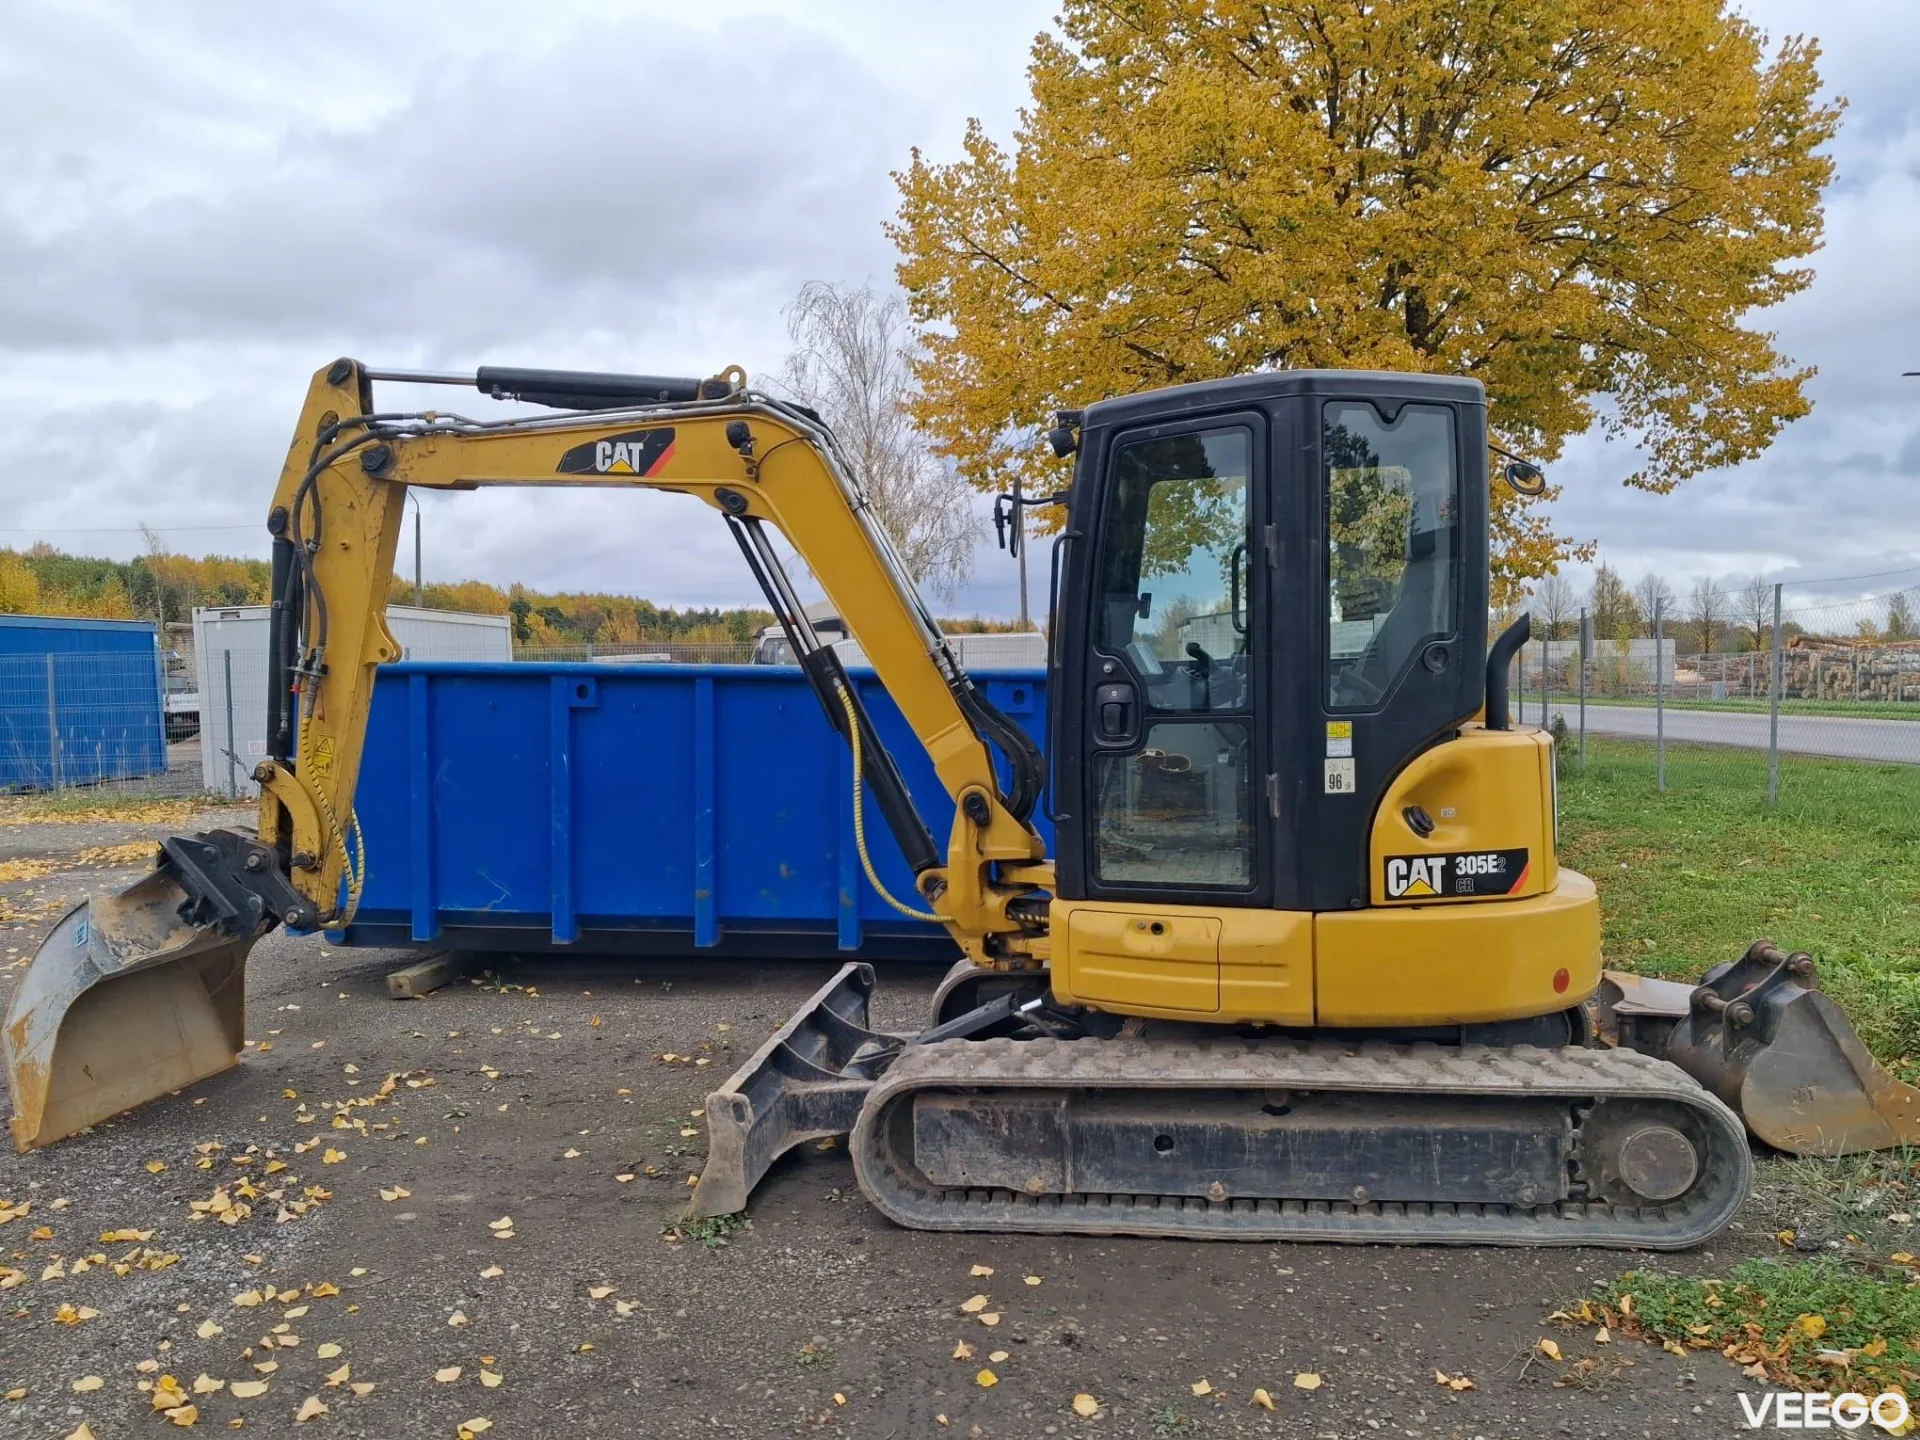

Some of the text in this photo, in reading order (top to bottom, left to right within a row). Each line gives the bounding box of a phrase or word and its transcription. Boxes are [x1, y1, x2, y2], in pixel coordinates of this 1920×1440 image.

[596, 441, 643, 473] CAT
[1329, 773, 1342, 790] 96
[1388, 854, 1506, 896] CAT 305E2
[1456, 878, 1474, 892] CR
